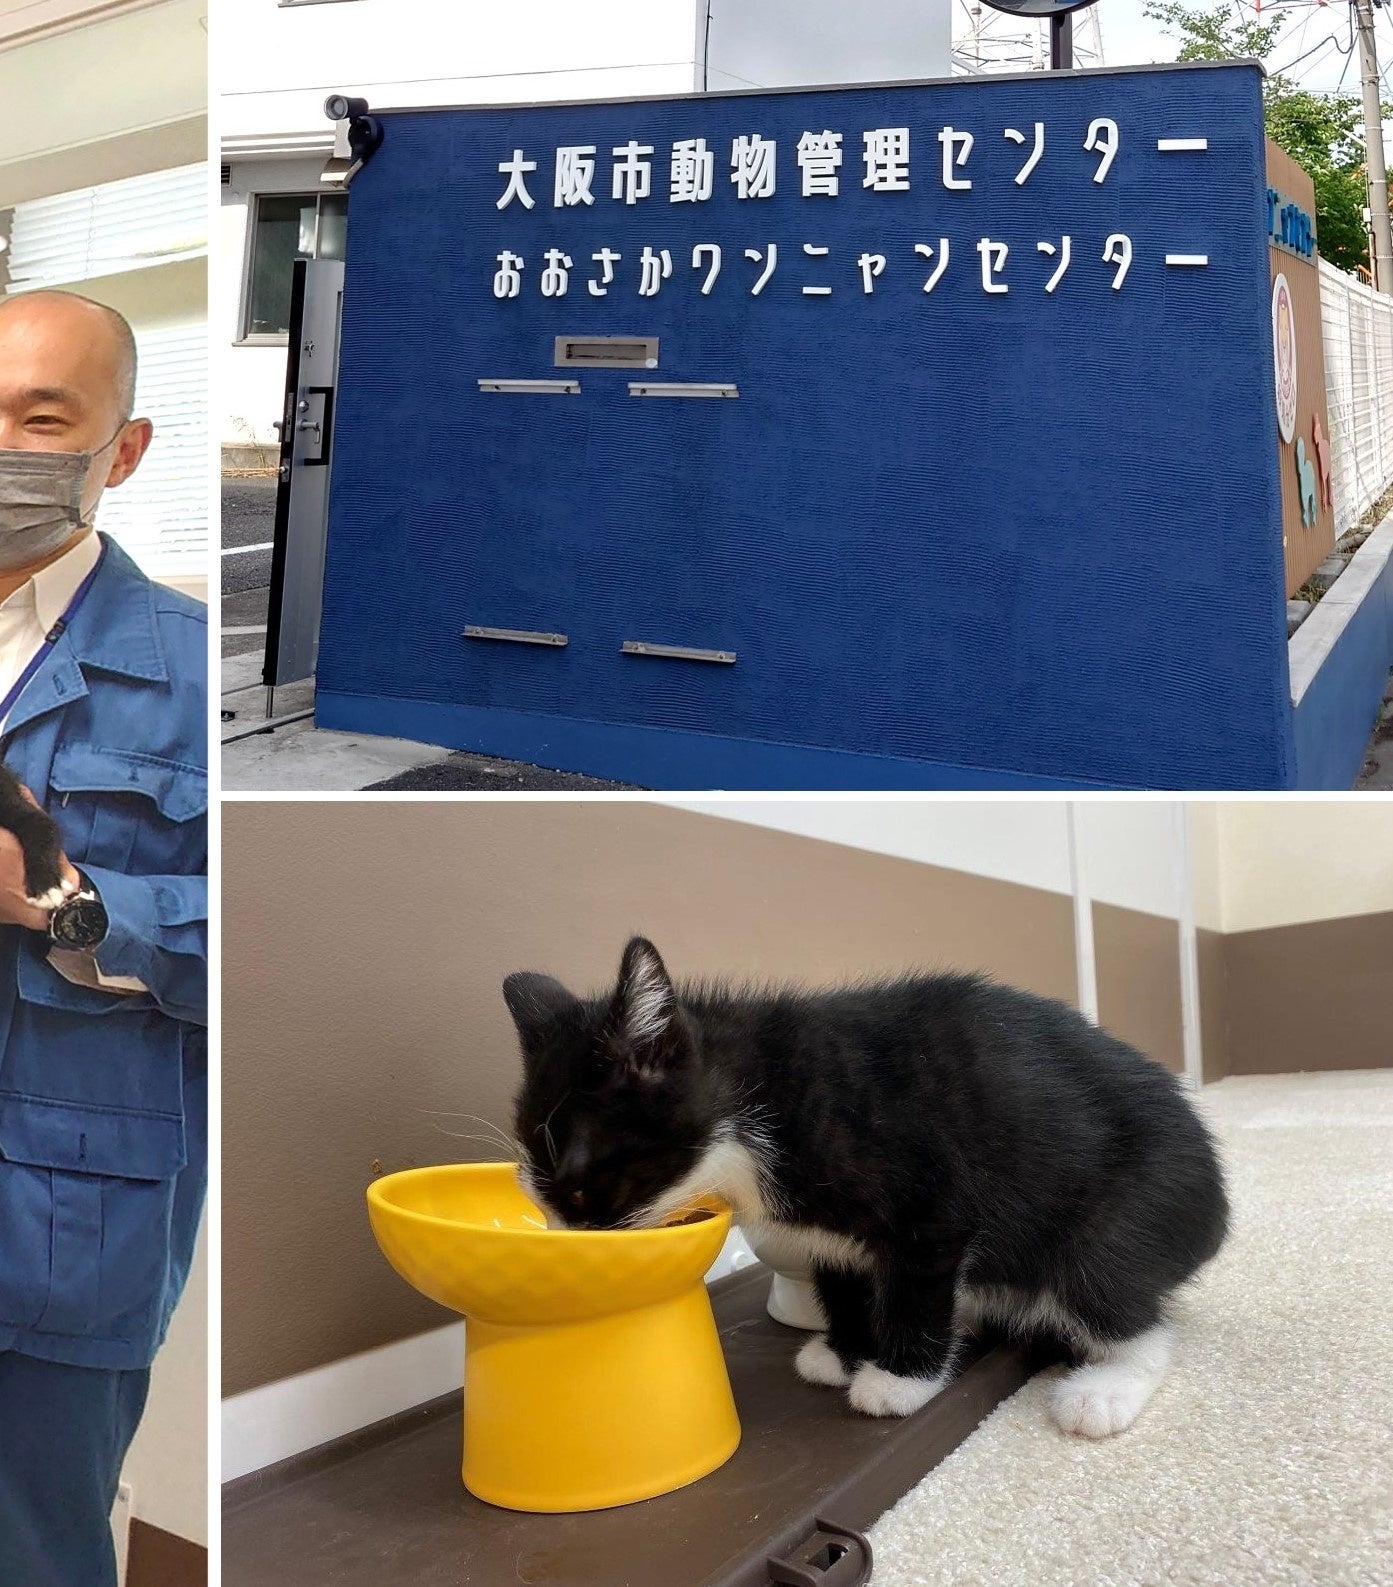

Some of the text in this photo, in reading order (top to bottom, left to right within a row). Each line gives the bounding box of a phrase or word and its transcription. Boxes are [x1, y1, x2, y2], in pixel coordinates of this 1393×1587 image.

[495, 117, 1209, 210] 大阪市動物管理センター
[493, 233, 1209, 298] おおさかワンニャンセンター
